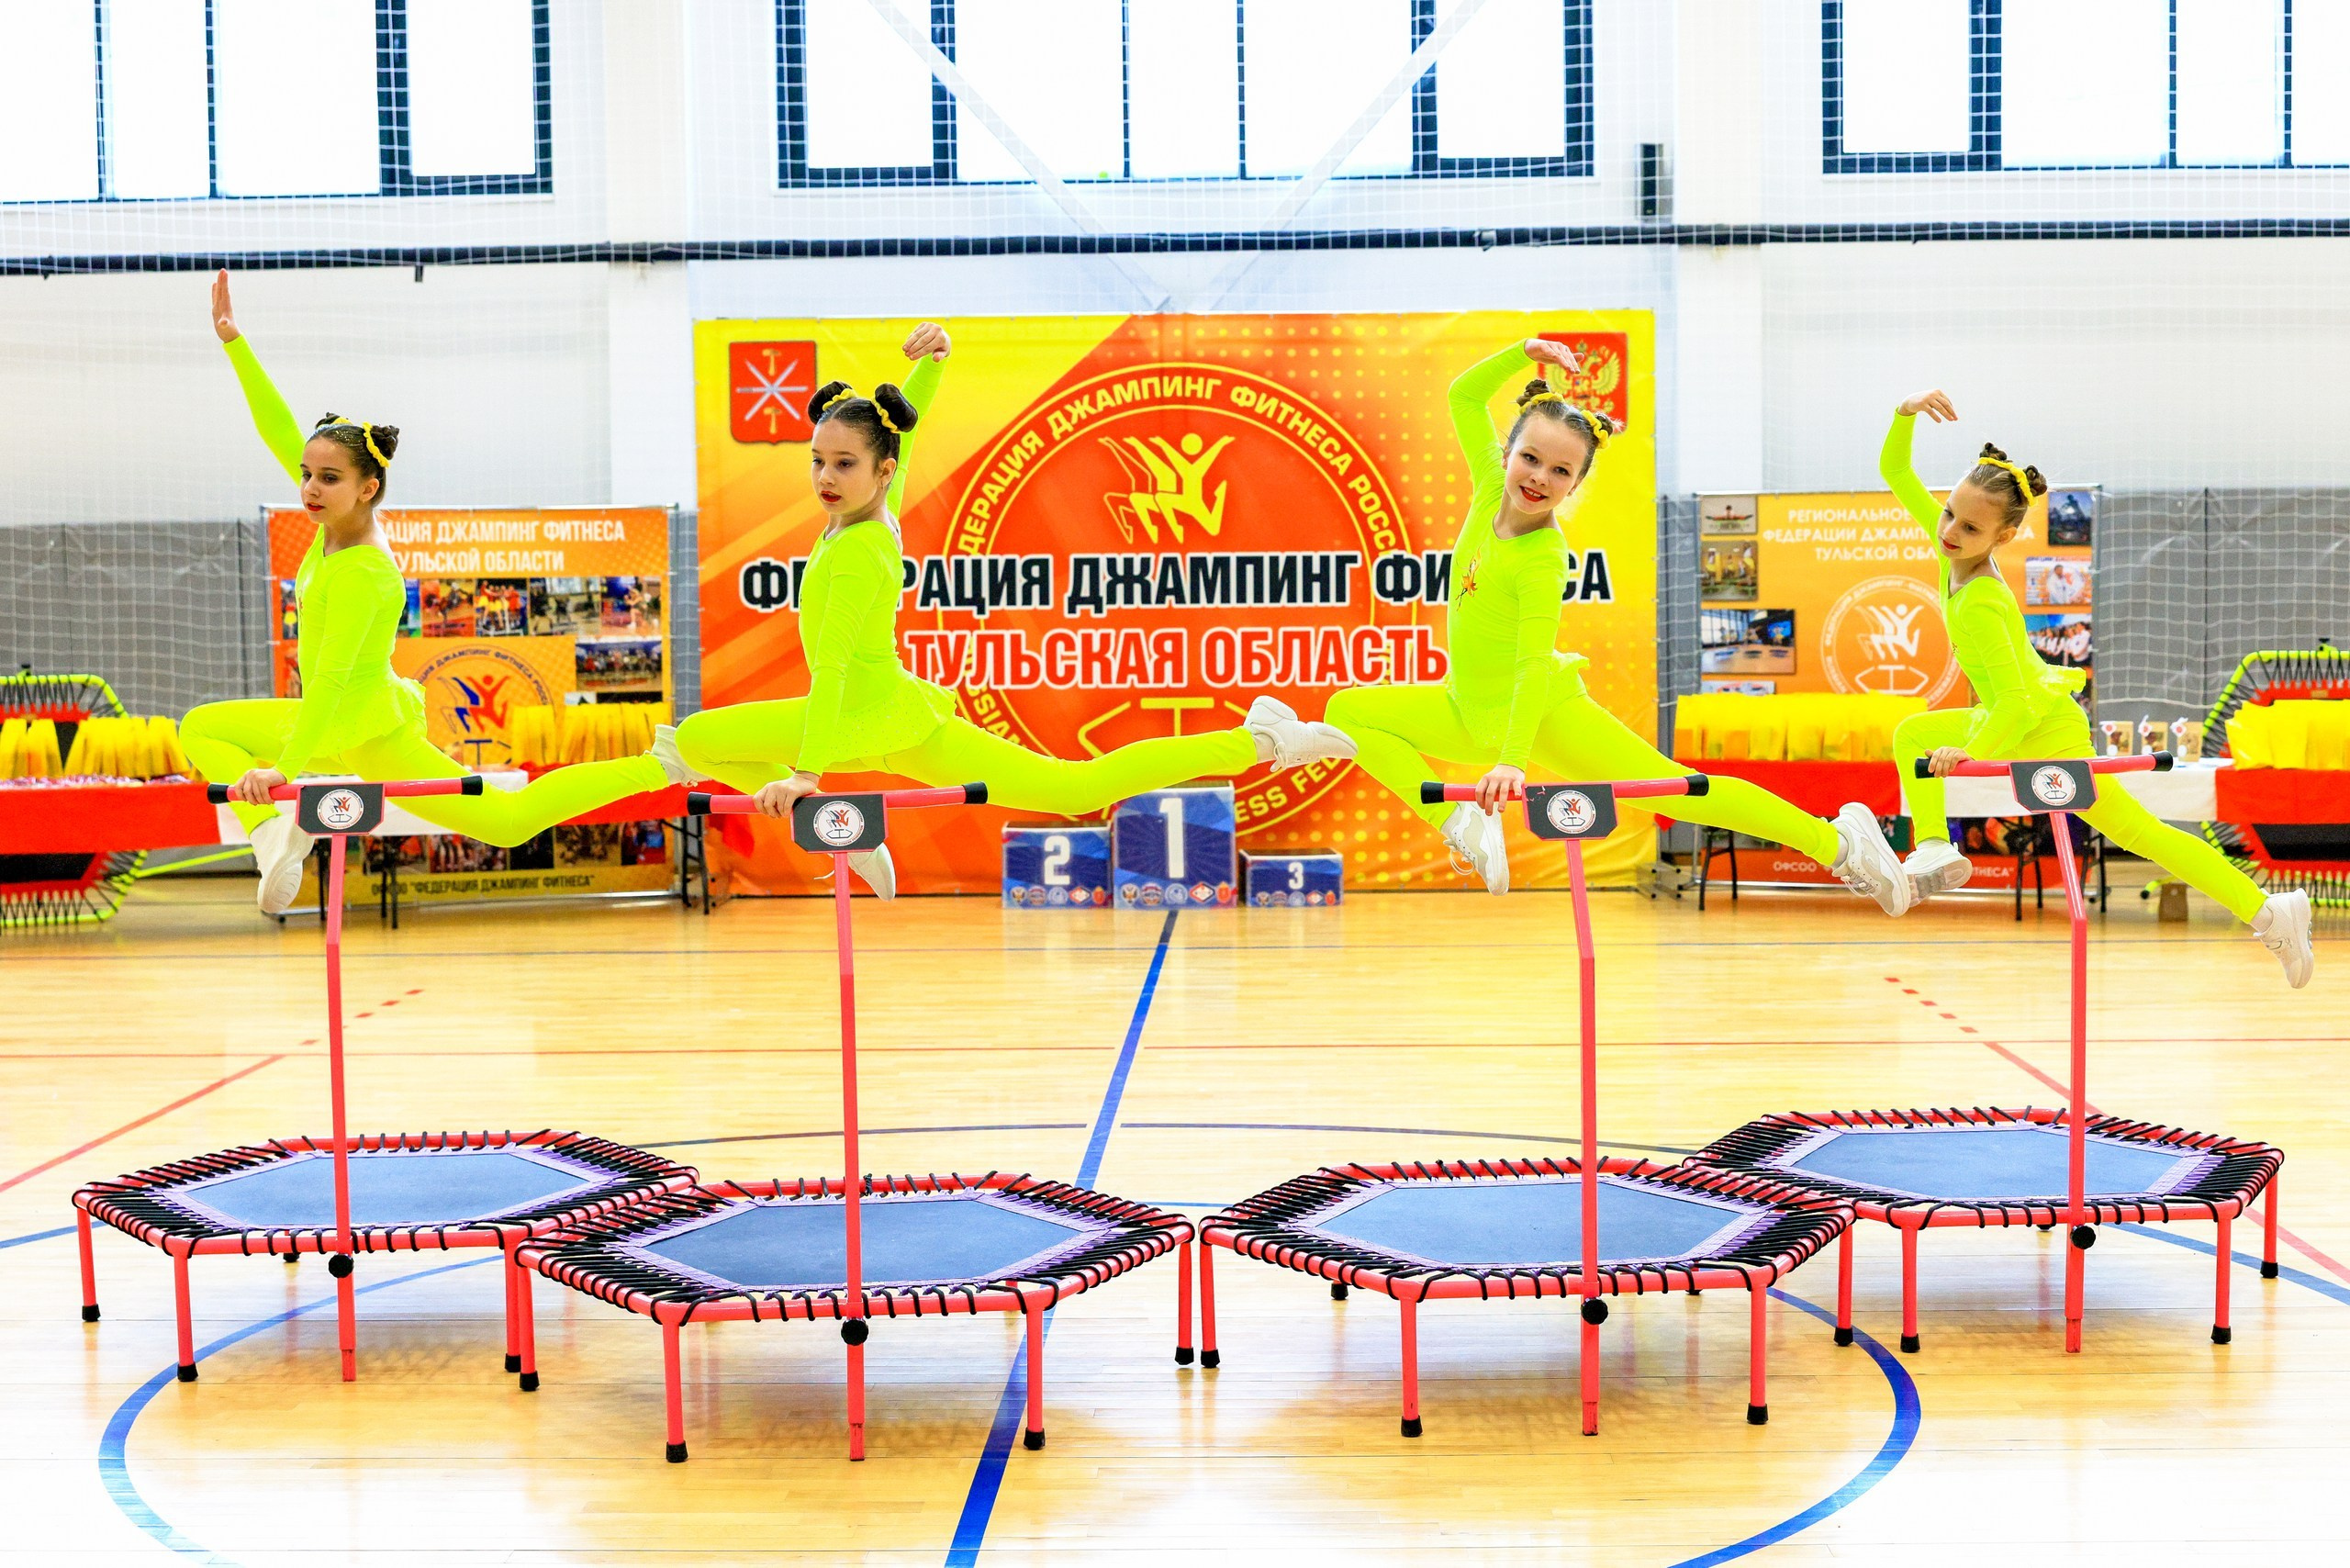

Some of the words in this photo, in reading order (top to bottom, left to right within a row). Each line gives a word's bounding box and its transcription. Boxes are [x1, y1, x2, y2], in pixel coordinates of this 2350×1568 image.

[1046, 375, 1223, 441] ДЖАМПИНГ
[1229, 386, 1354, 476] ФИТНЕСА
[1347, 474, 1403, 556] РОСС
[435, 521, 540, 545] ДЖАМПИНГ
[543, 520, 626, 542] ФИТНЕСА
[1762, 528, 1856, 543] ФЕДЕРАЦИИ
[1861, 526, 1930, 543] ДЖАМП
[1815, 543, 1898, 561] ТУЛЬСКОЙ
[485, 551, 565, 572] ОБЛАСТИ
[1065, 552, 1361, 616] ДЖАМПИНГ
[905, 628, 1187, 689] ТУЛЬСКАЯ
[1201, 625, 1449, 687] ОБЛАСТЬ
[1158, 797, 1185, 879] 1
[1043, 834, 1070, 886] 2
[1288, 861, 1304, 890] 3
